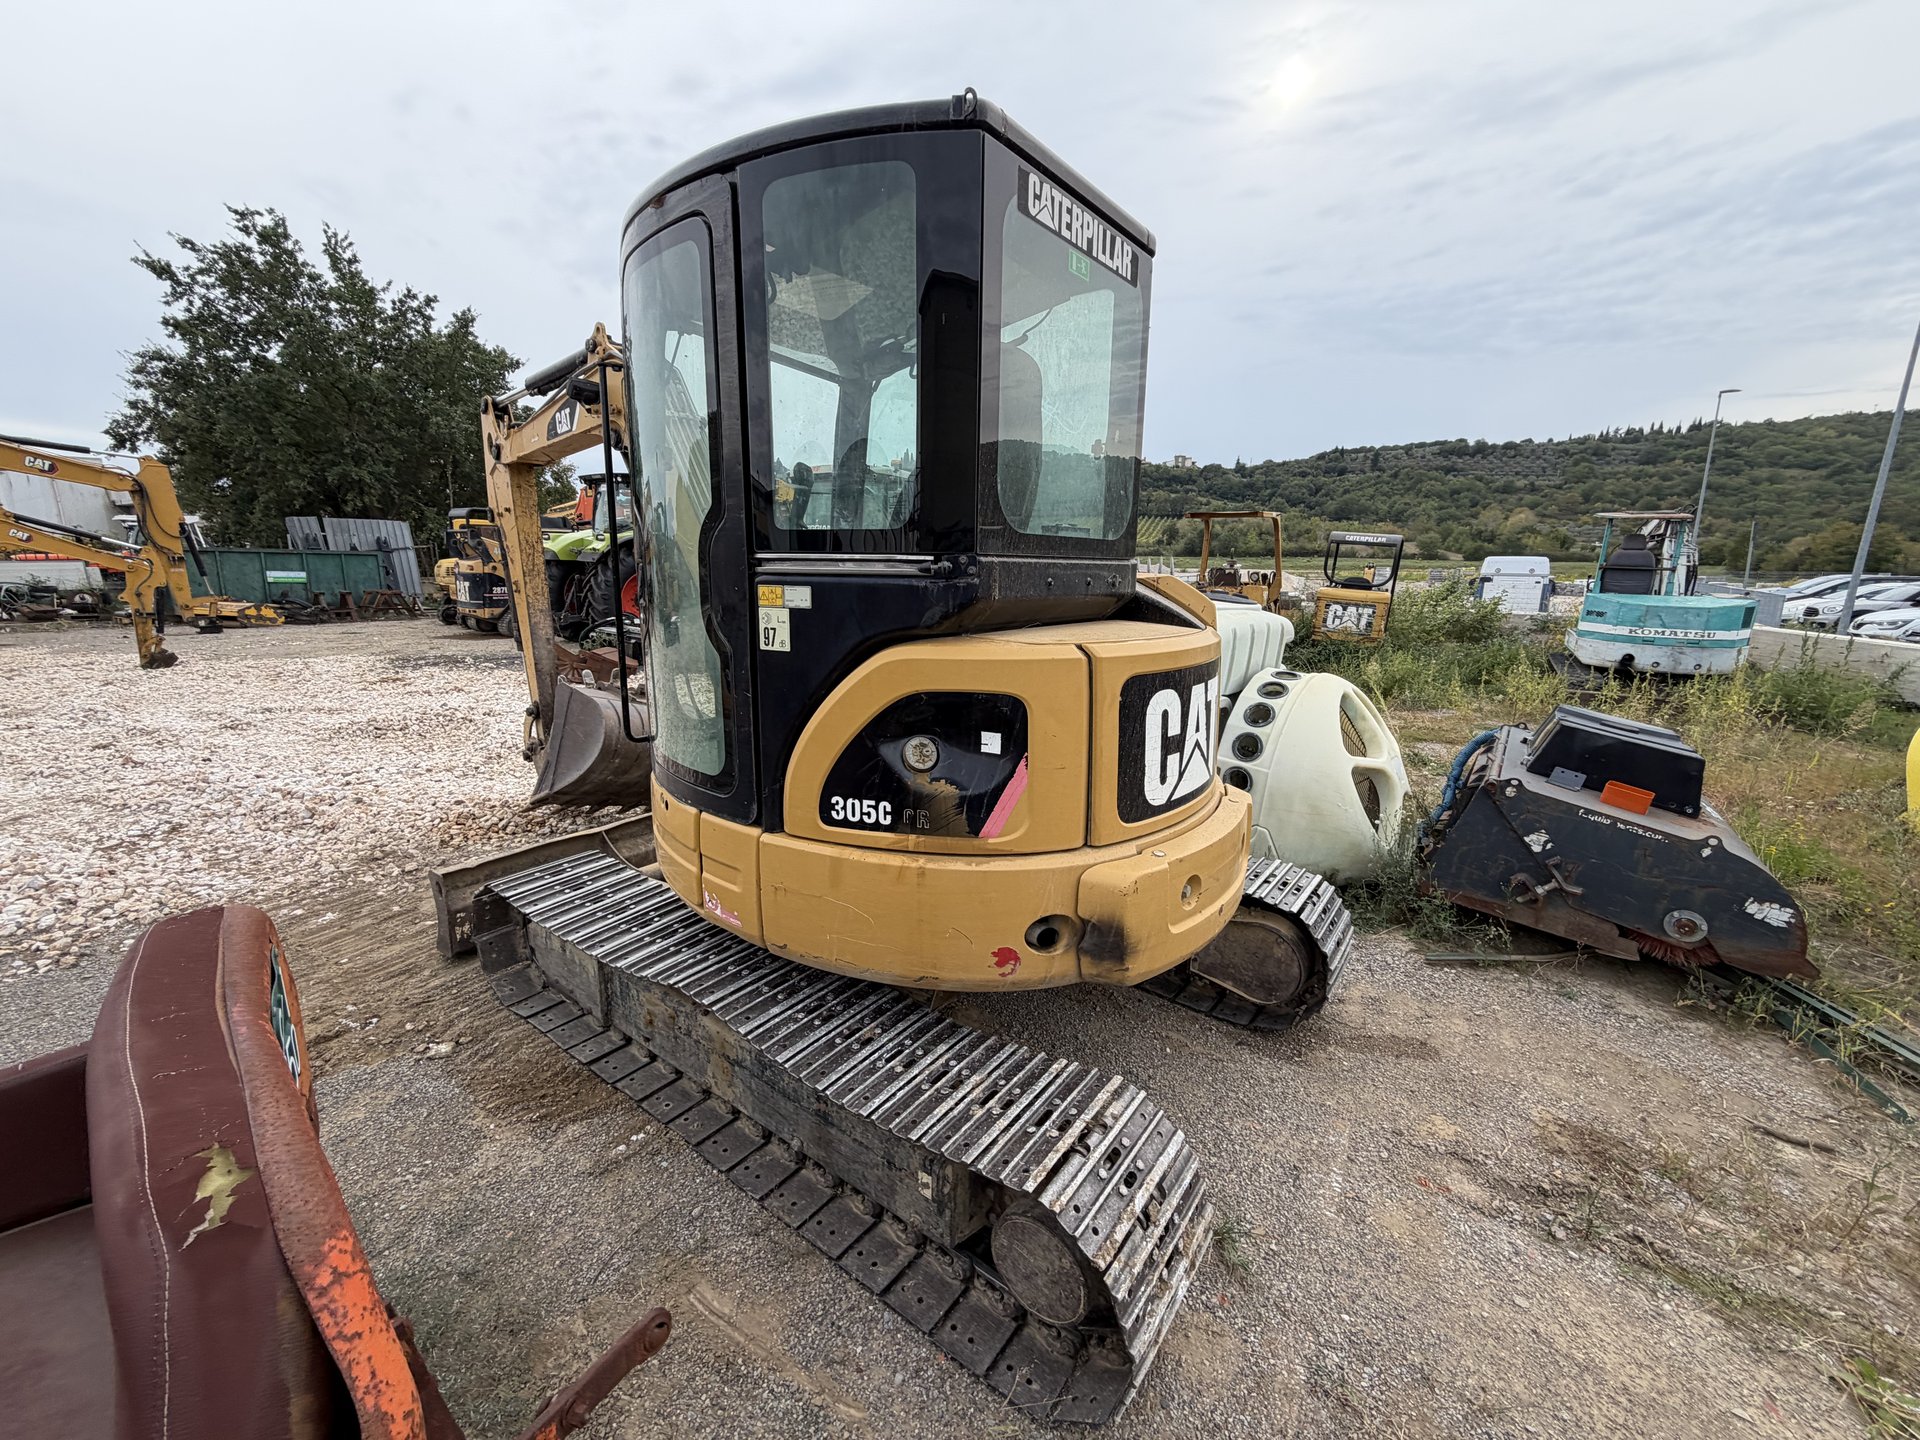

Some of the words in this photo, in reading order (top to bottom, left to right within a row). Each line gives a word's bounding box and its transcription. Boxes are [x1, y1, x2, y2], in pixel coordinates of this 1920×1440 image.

[1028, 172, 1133, 281] CATERPILLAR
[555, 407, 571, 434] CAT
[24, 455, 52, 471] CAT
[8, 528, 30, 541] CAT
[1345, 535, 1387, 543] CATERPILLAR
[456, 580, 470, 602] AT
[1326, 604, 1375, 631] CAT
[763, 626, 777, 648] 97
[778, 639, 787, 648] dB
[1628, 628, 1717, 639] KOMATSU
[1143, 674, 1220, 807] CAT
[830, 796, 892, 825] 305C
